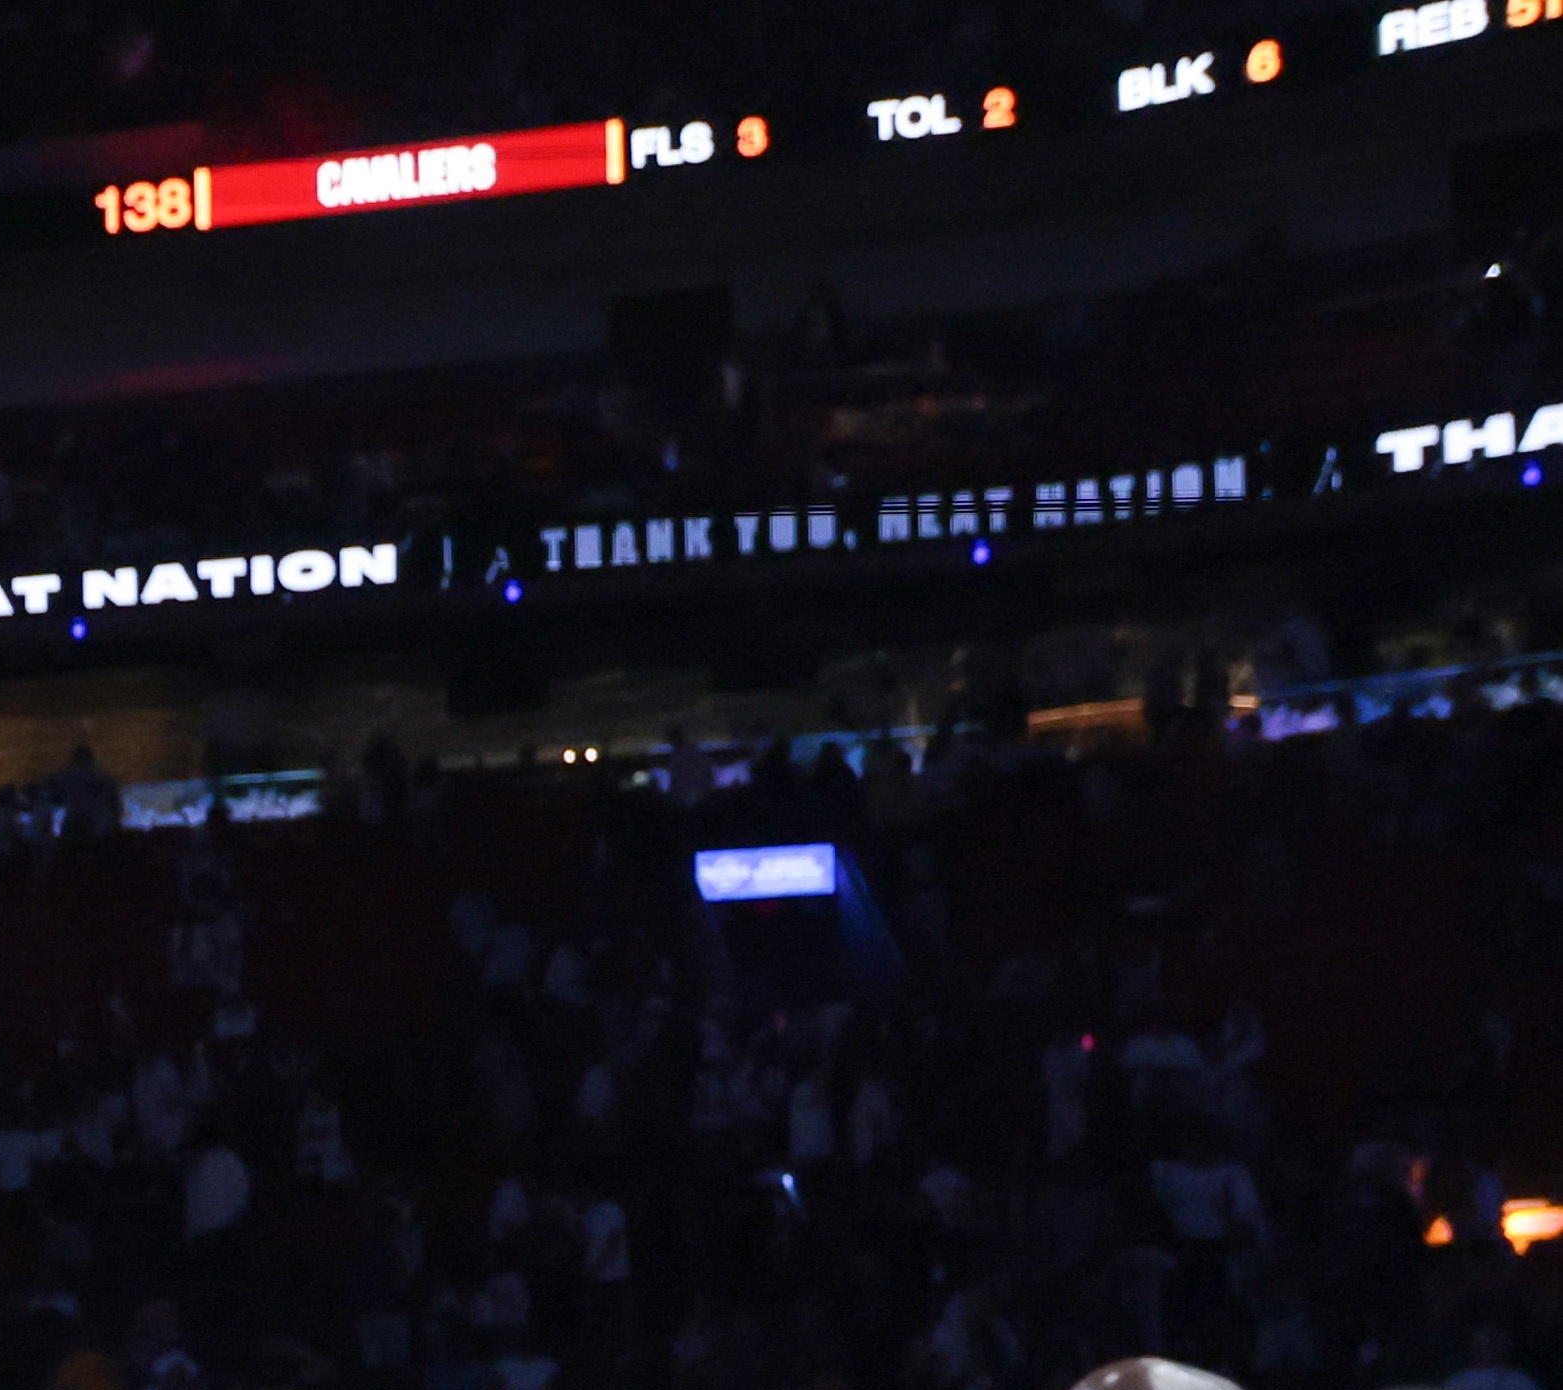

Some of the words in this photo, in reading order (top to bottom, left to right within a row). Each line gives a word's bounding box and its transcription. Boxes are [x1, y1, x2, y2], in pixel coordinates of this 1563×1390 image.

[631, 121, 714, 169] FLS
[867, 94, 962, 140] TOL
[983, 87, 1016, 128] 2
[1118, 53, 1215, 111] BLK
[1246, 39, 1282, 82] 6
[1378, 0, 1489, 55] REB
[95, 177, 192, 234] 138
[318, 144, 495, 207] CAVALIERS
[83, 544, 397, 609] NATION
